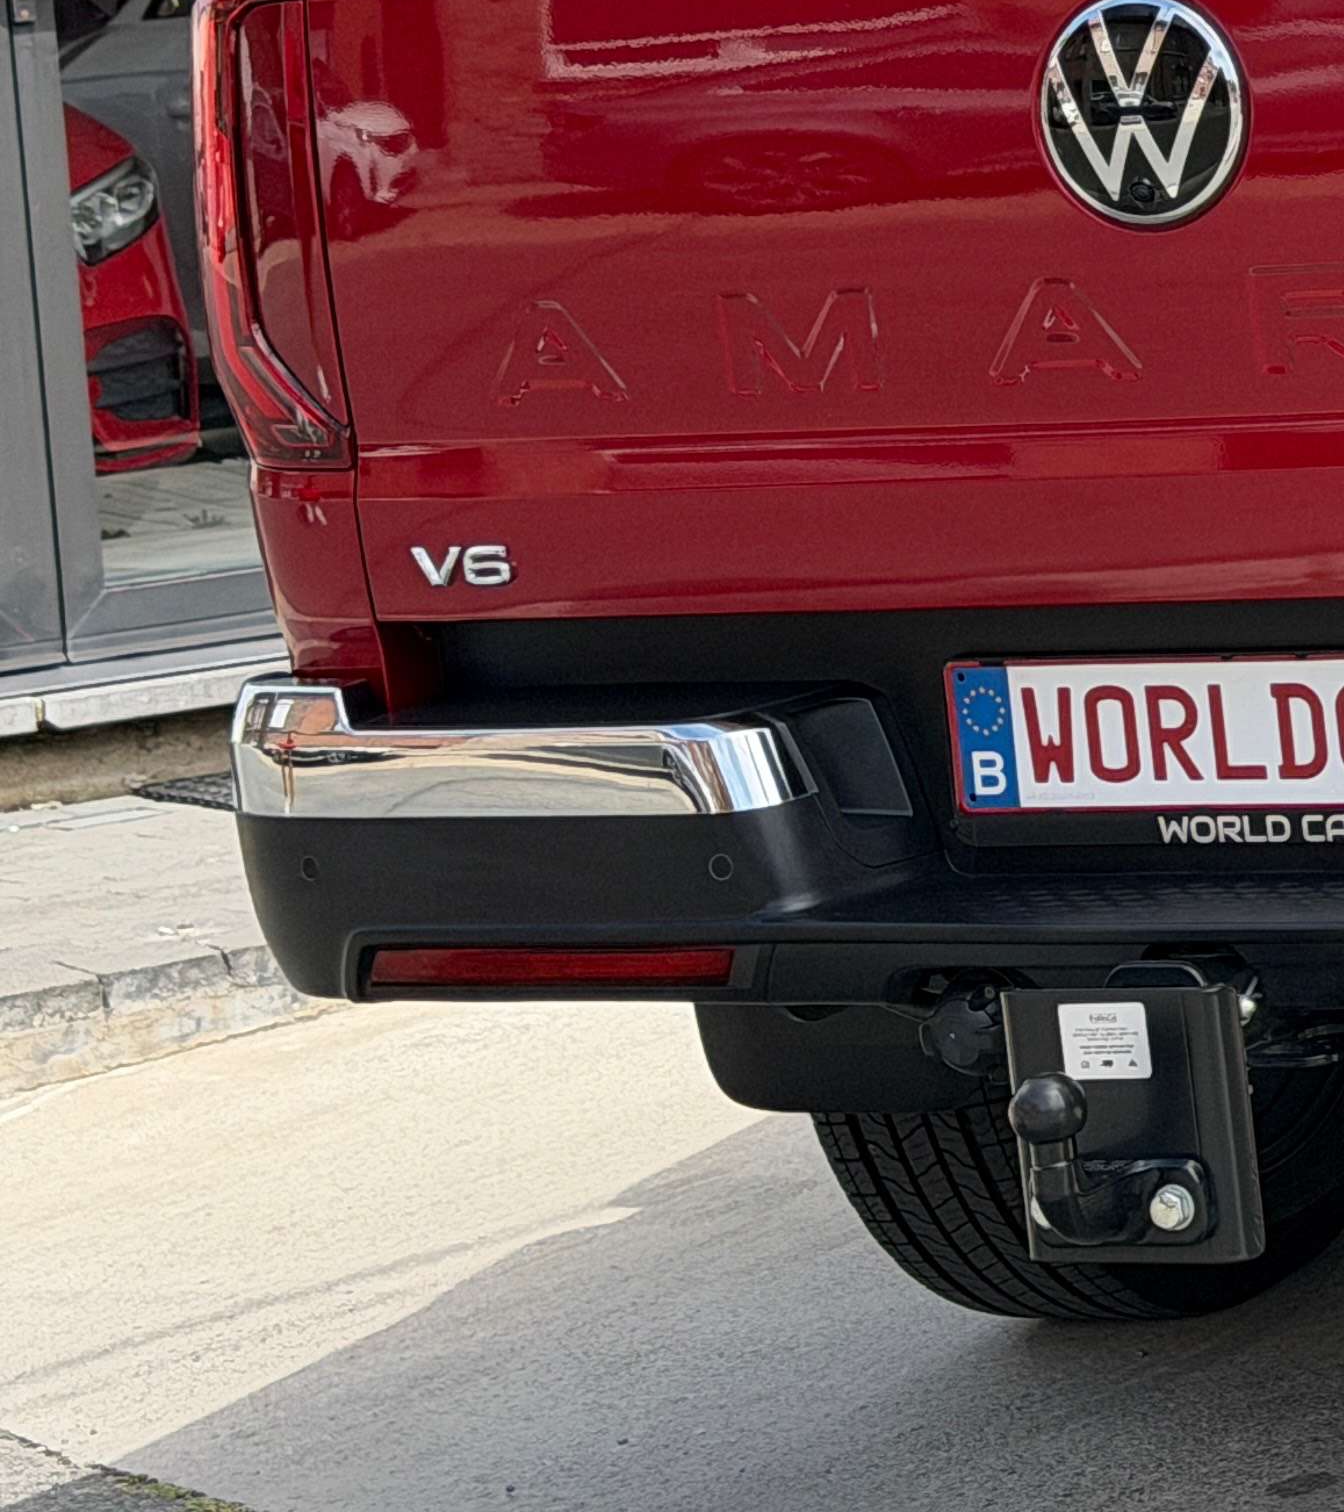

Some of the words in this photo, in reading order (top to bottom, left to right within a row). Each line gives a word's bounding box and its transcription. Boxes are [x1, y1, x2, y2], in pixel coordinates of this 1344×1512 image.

[410, 544, 512, 587] V6
[971, 750, 1007, 797] B
[1157, 814, 1292, 845] WORLD
